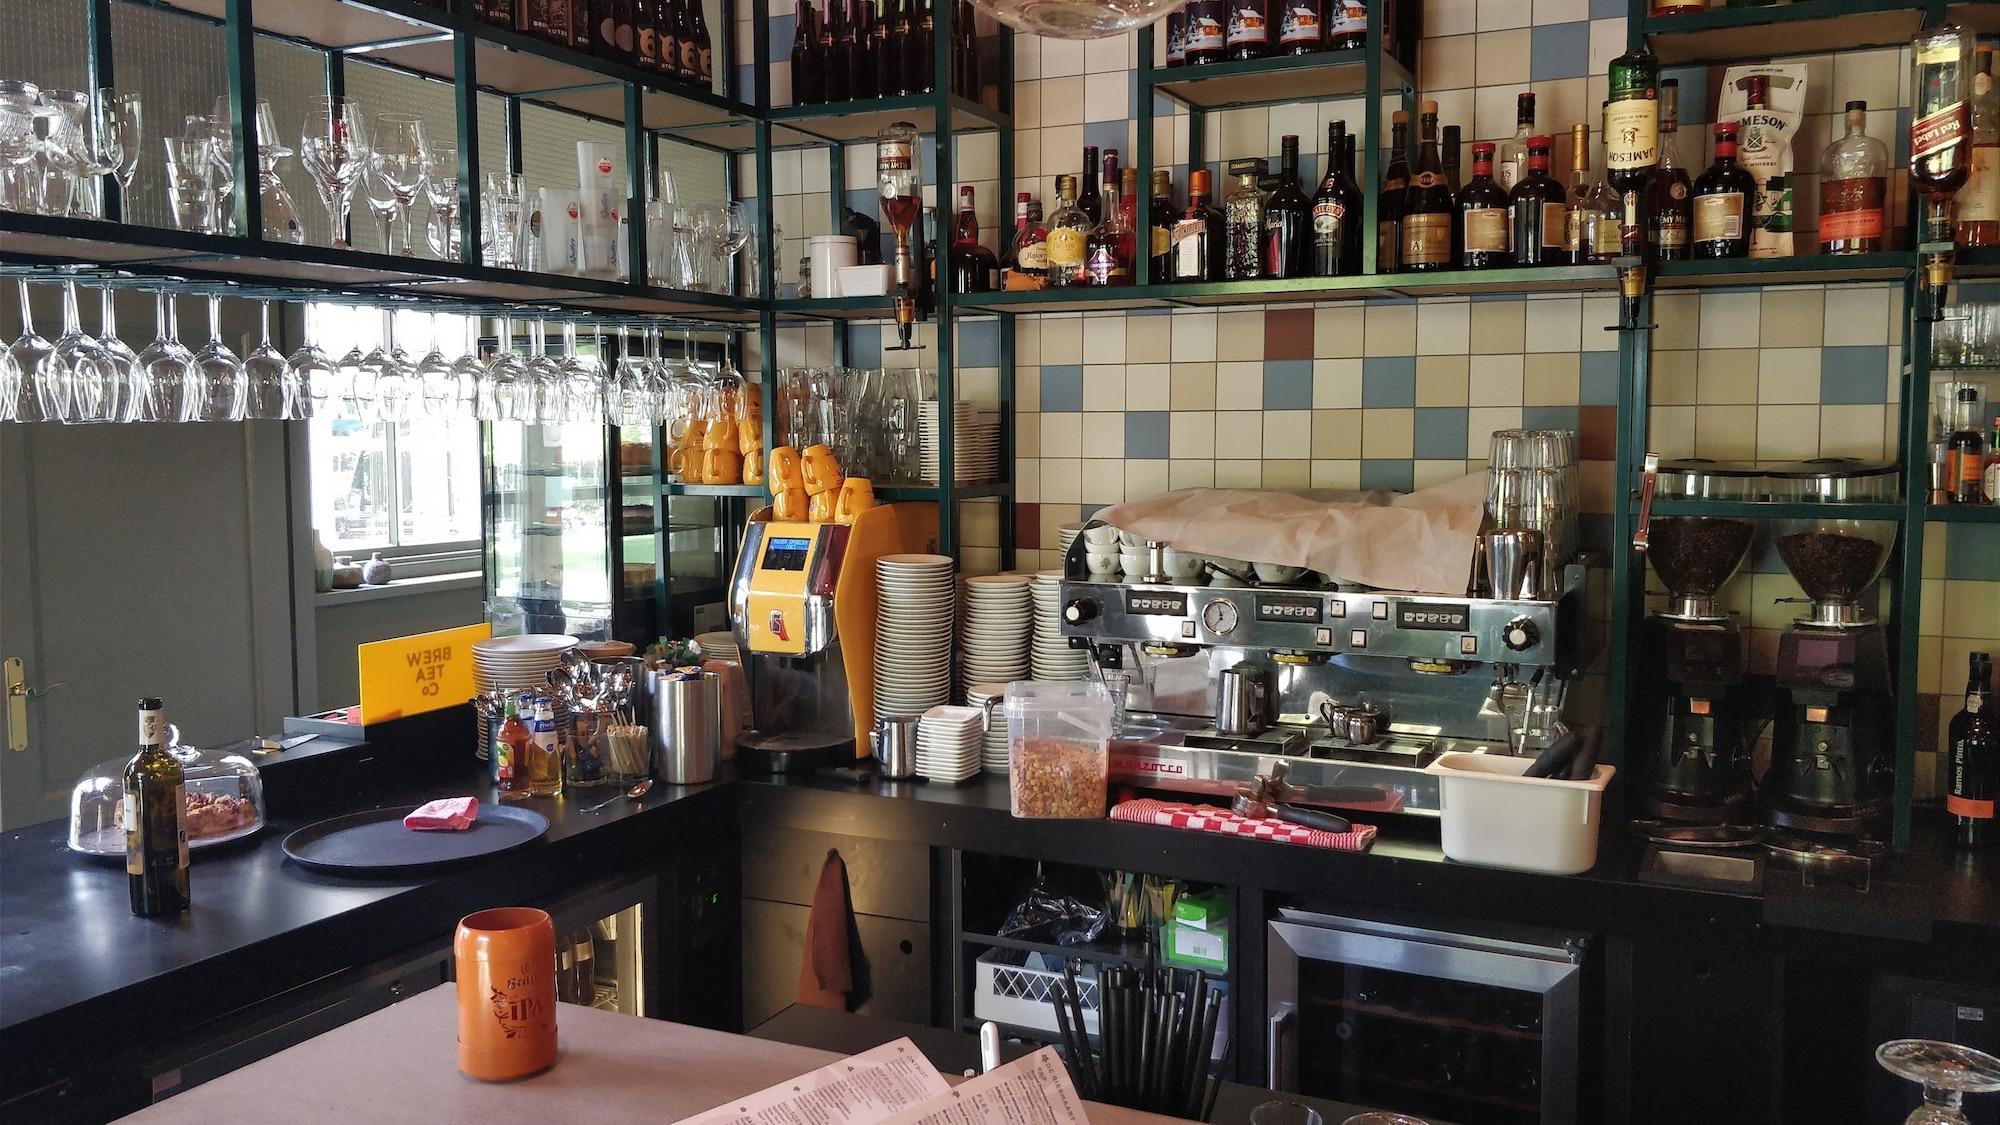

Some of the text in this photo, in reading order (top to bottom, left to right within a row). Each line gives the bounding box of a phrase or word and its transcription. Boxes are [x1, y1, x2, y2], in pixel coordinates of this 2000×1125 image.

[1737, 114, 1786, 131] MESON
[1913, 119, 1961, 147] Red Label
[1608, 147, 1654, 163] JAMESON
[1954, 765, 1963, 795] Ramos
